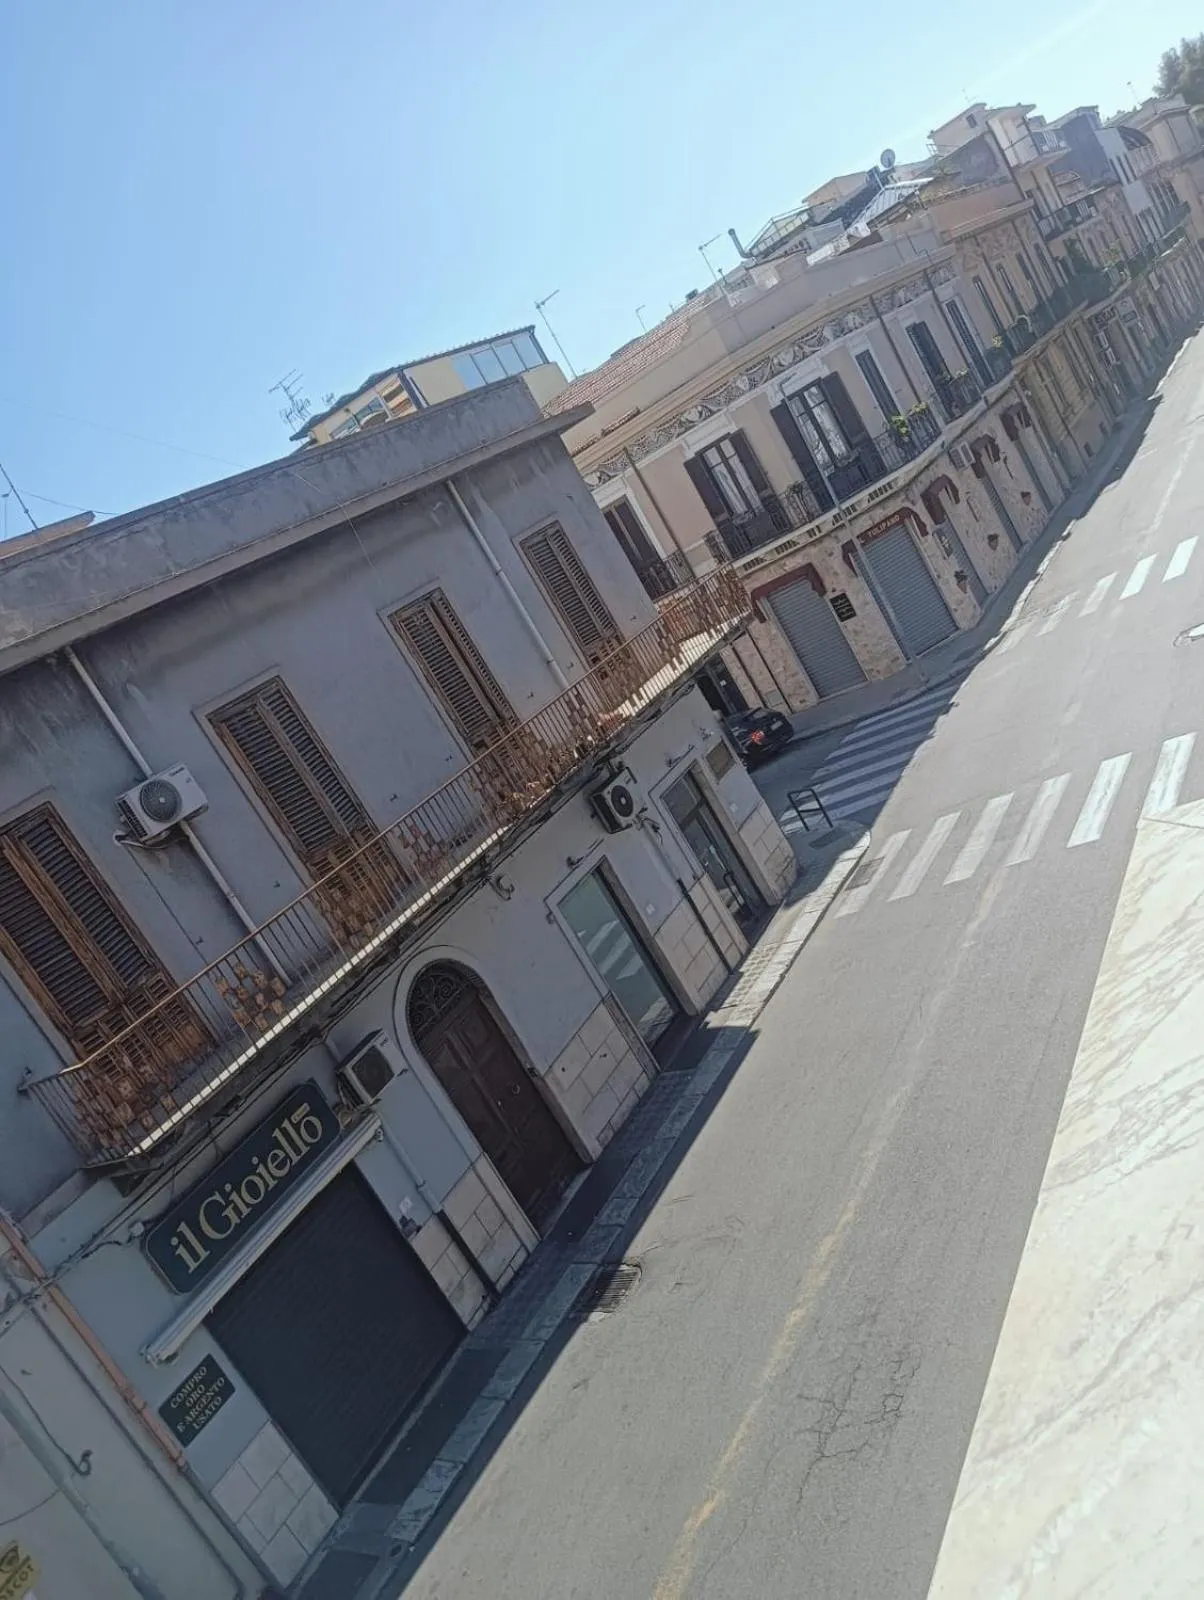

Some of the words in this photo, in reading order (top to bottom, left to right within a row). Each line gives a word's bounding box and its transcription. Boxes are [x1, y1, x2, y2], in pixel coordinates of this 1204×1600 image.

[170, 1221, 211, 1274] il
[170, 1366, 208, 1408] COMPRO
[184, 1376, 225, 1425] ARGENTO
[185, 1384, 205, 1408] ORO
[193, 1396, 222, 1430] USATO
